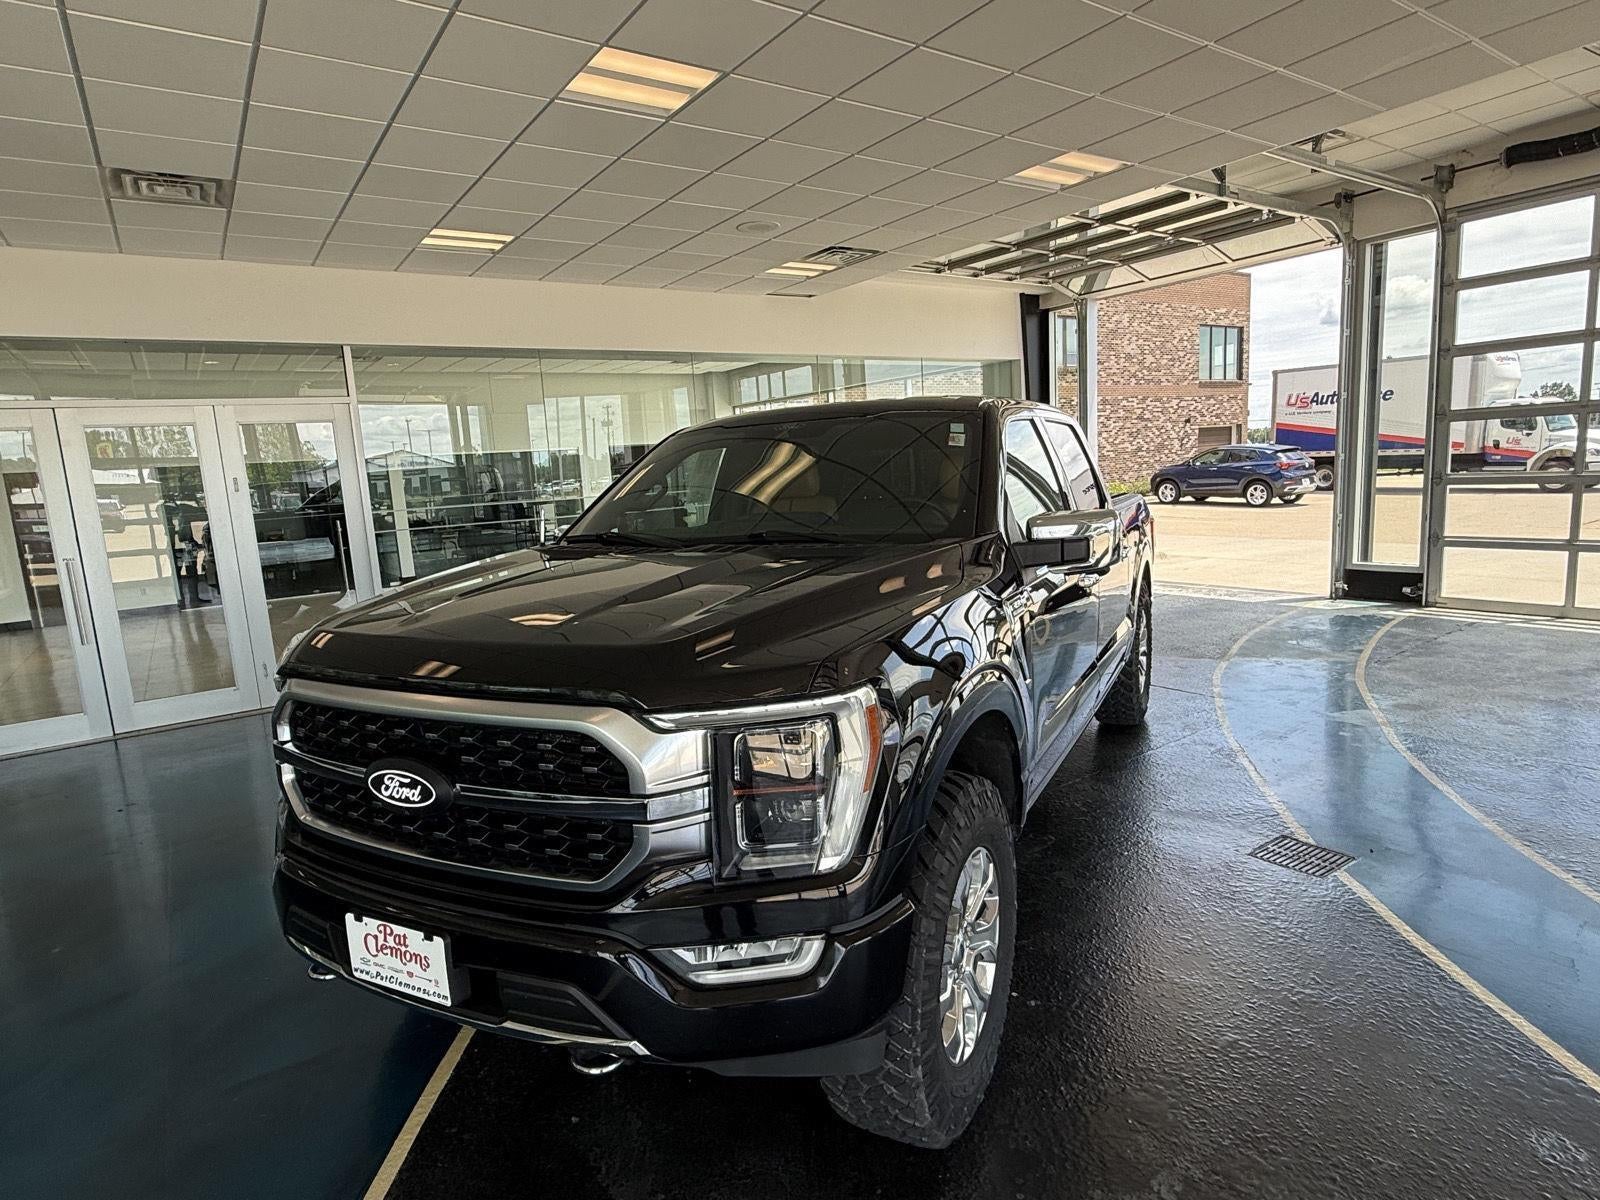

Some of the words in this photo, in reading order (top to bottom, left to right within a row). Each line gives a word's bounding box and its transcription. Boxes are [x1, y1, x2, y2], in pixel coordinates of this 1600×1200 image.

[381, 774, 421, 801] Ford
[377, 923, 409, 949] Pat
[364, 932, 430, 972] Clemons
